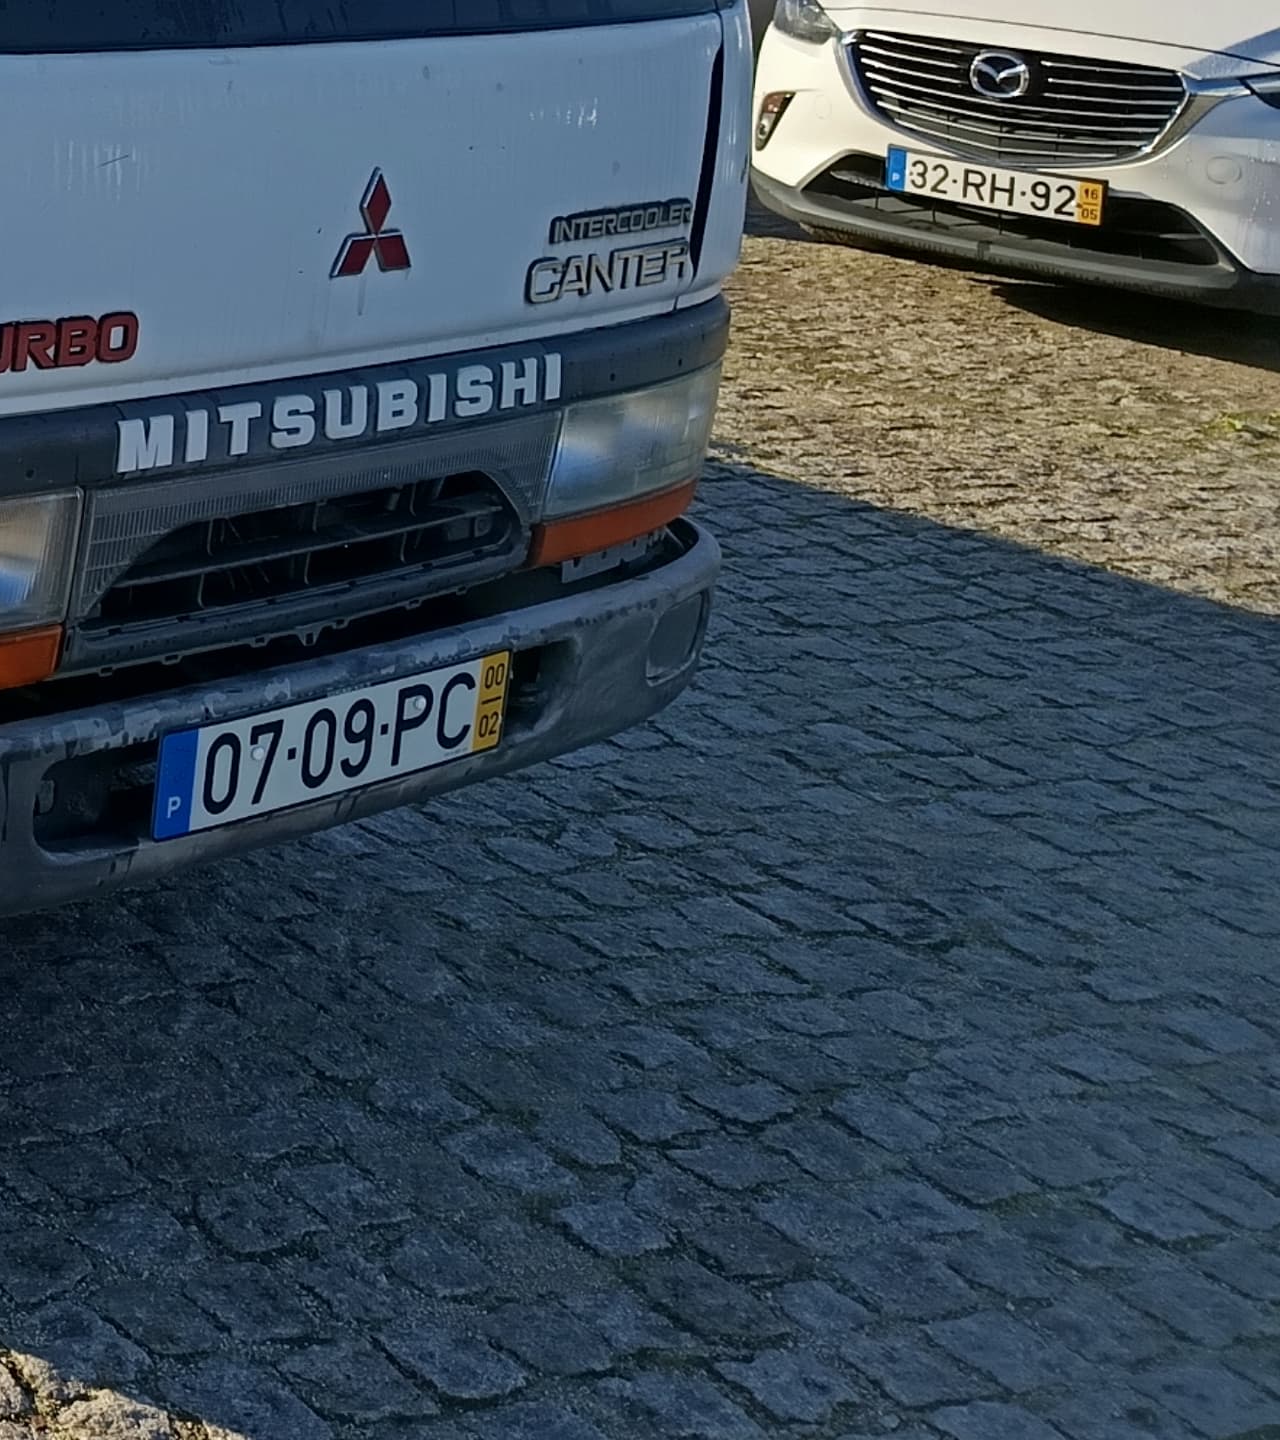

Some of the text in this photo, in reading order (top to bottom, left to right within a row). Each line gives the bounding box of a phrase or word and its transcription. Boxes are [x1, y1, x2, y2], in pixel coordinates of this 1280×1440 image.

[550, 198, 691, 244] INTERCOOLER
[1081, 208, 1098, 221] 05
[526, 239, 690, 305] CANTER
[117, 354, 561, 473] MITSUBISHI
[485, 663, 505, 689] 00
[479, 711, 499, 738] 02
[167, 796, 181, 818] P
